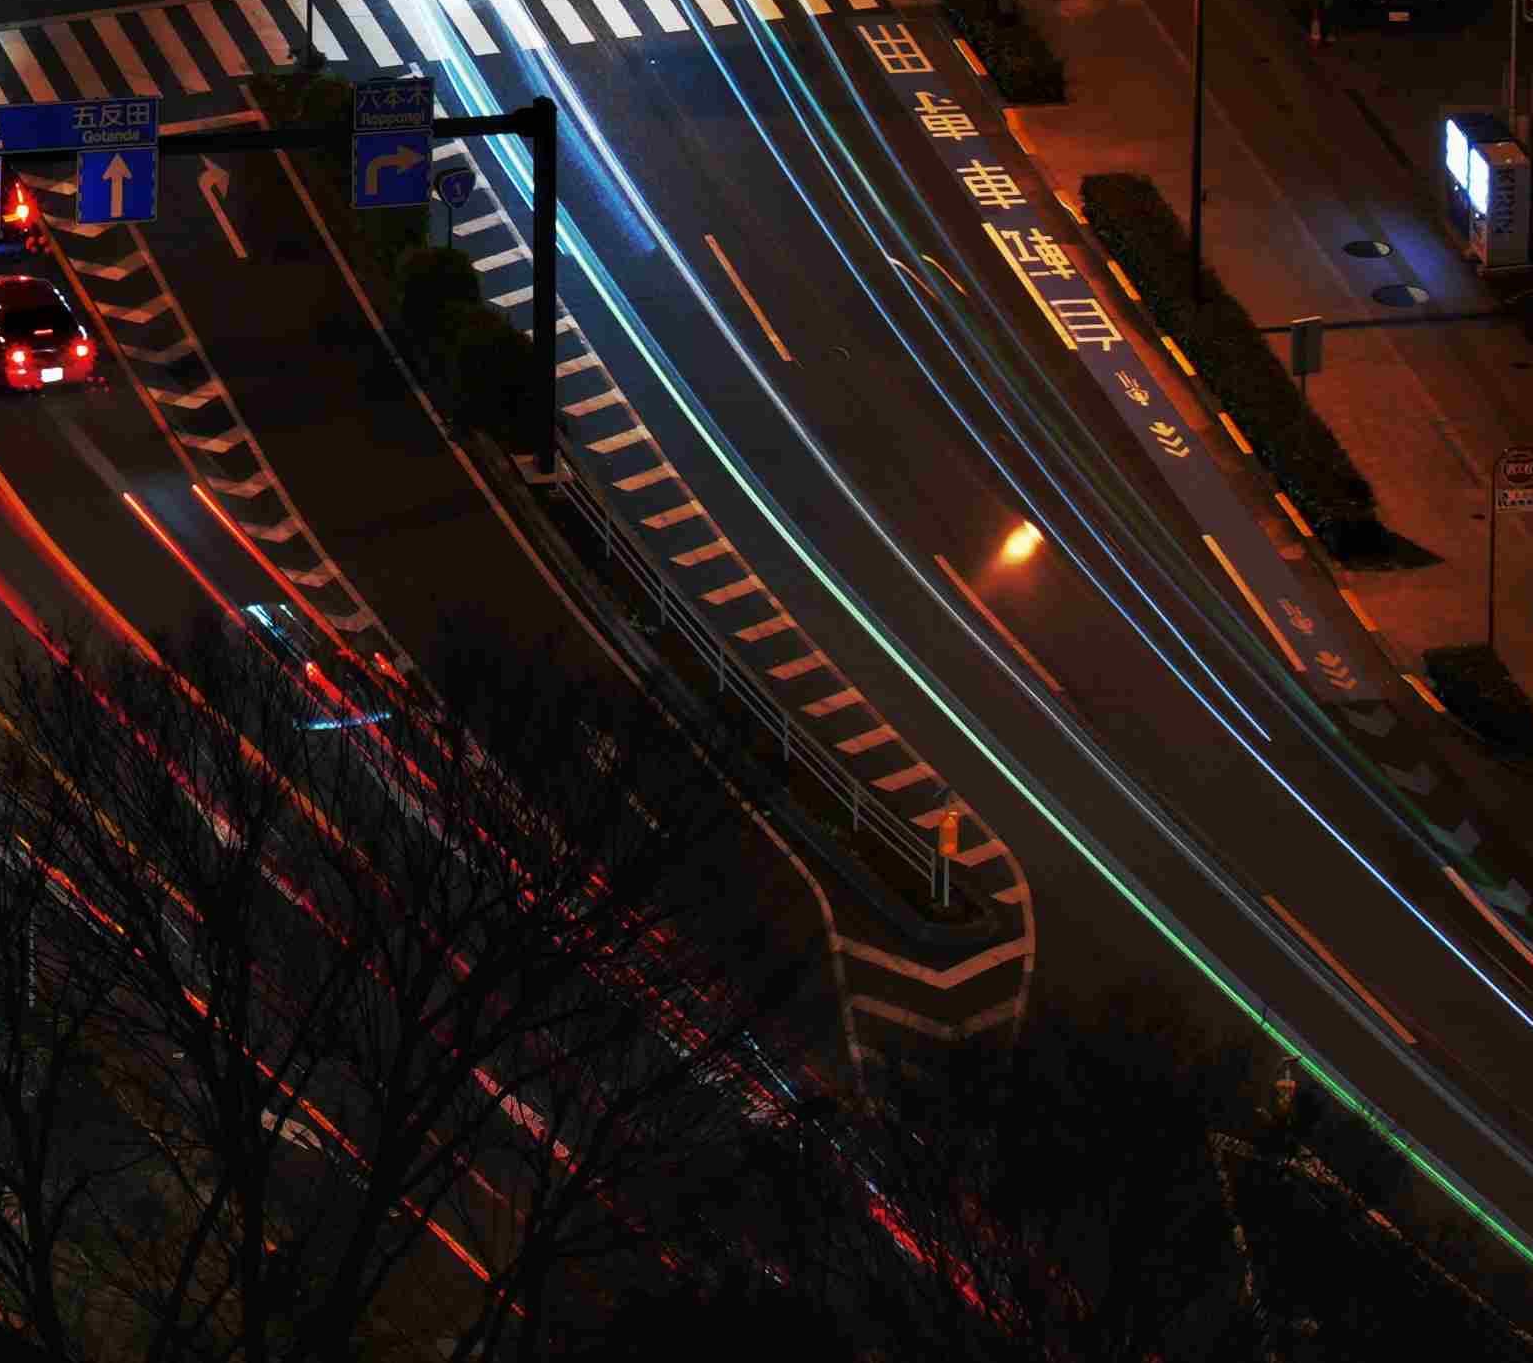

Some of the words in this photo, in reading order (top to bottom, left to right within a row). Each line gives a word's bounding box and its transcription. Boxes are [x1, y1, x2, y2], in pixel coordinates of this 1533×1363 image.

[73, 102, 150, 130] 五反田
[82, 127, 141, 146] Gotanda
